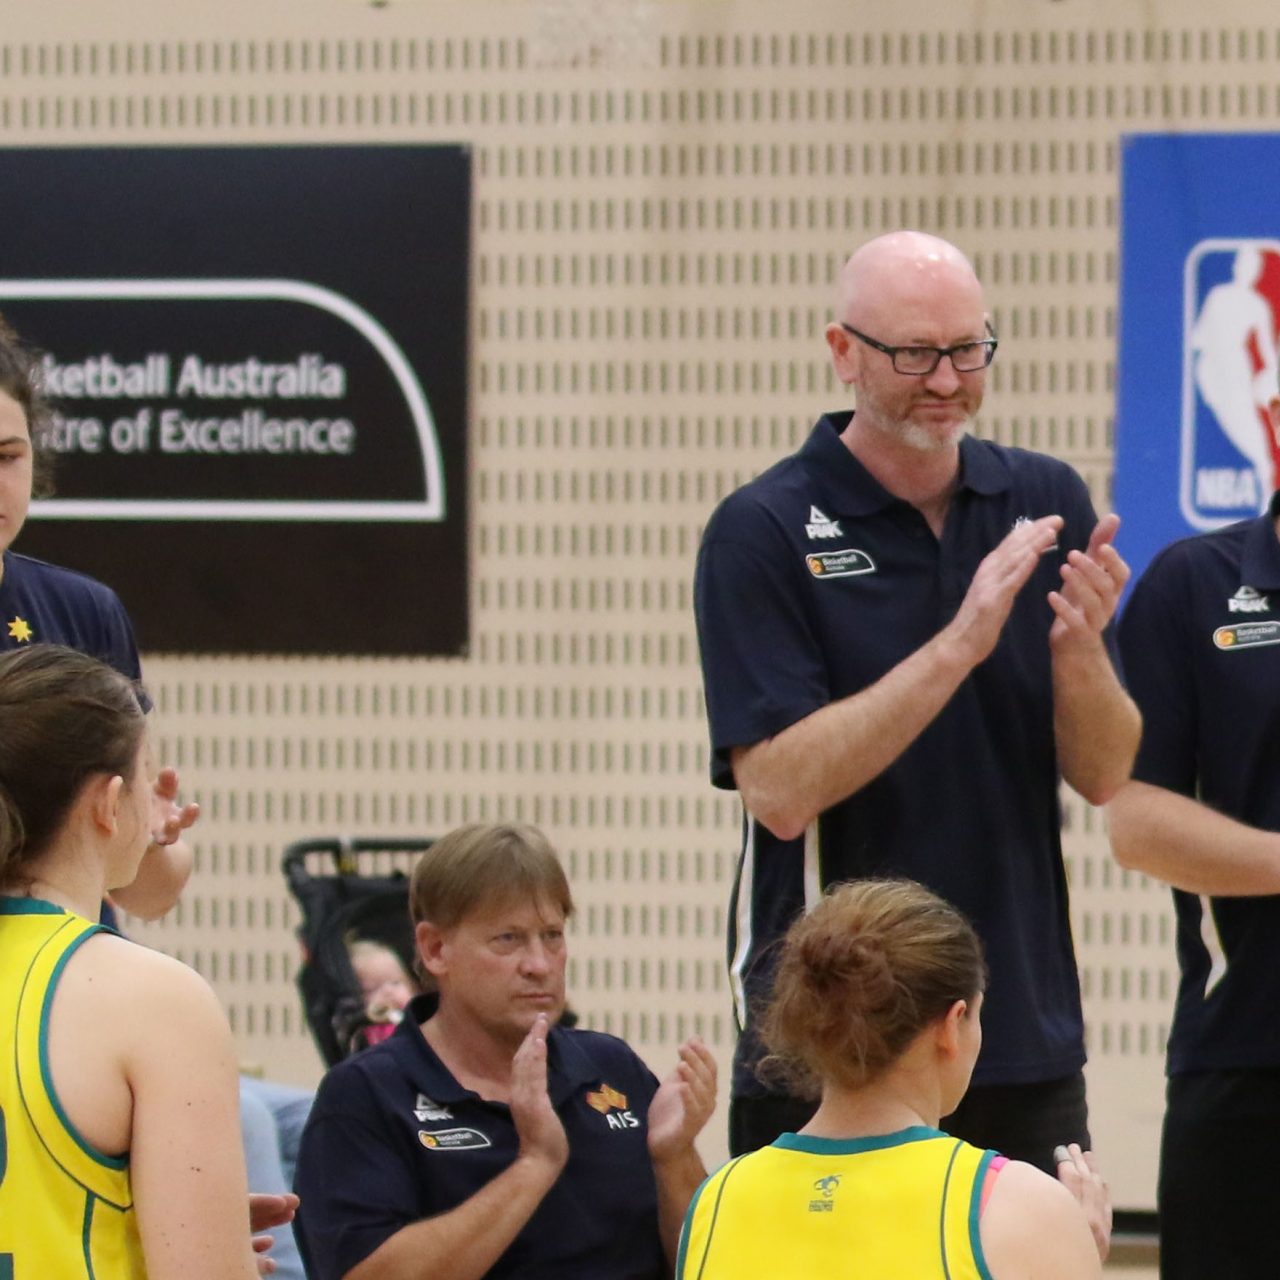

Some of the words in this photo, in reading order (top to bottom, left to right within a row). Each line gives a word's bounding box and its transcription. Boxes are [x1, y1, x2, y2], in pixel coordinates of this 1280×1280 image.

[43, 354, 168, 398] ketball
[176, 354, 347, 398] Australia
[45, 412, 102, 451] tre
[110, 408, 149, 451] of
[159, 409, 355, 452] Excellence
[1198, 468, 1257, 508] NBA
[606, 1111, 640, 1130] AIS
